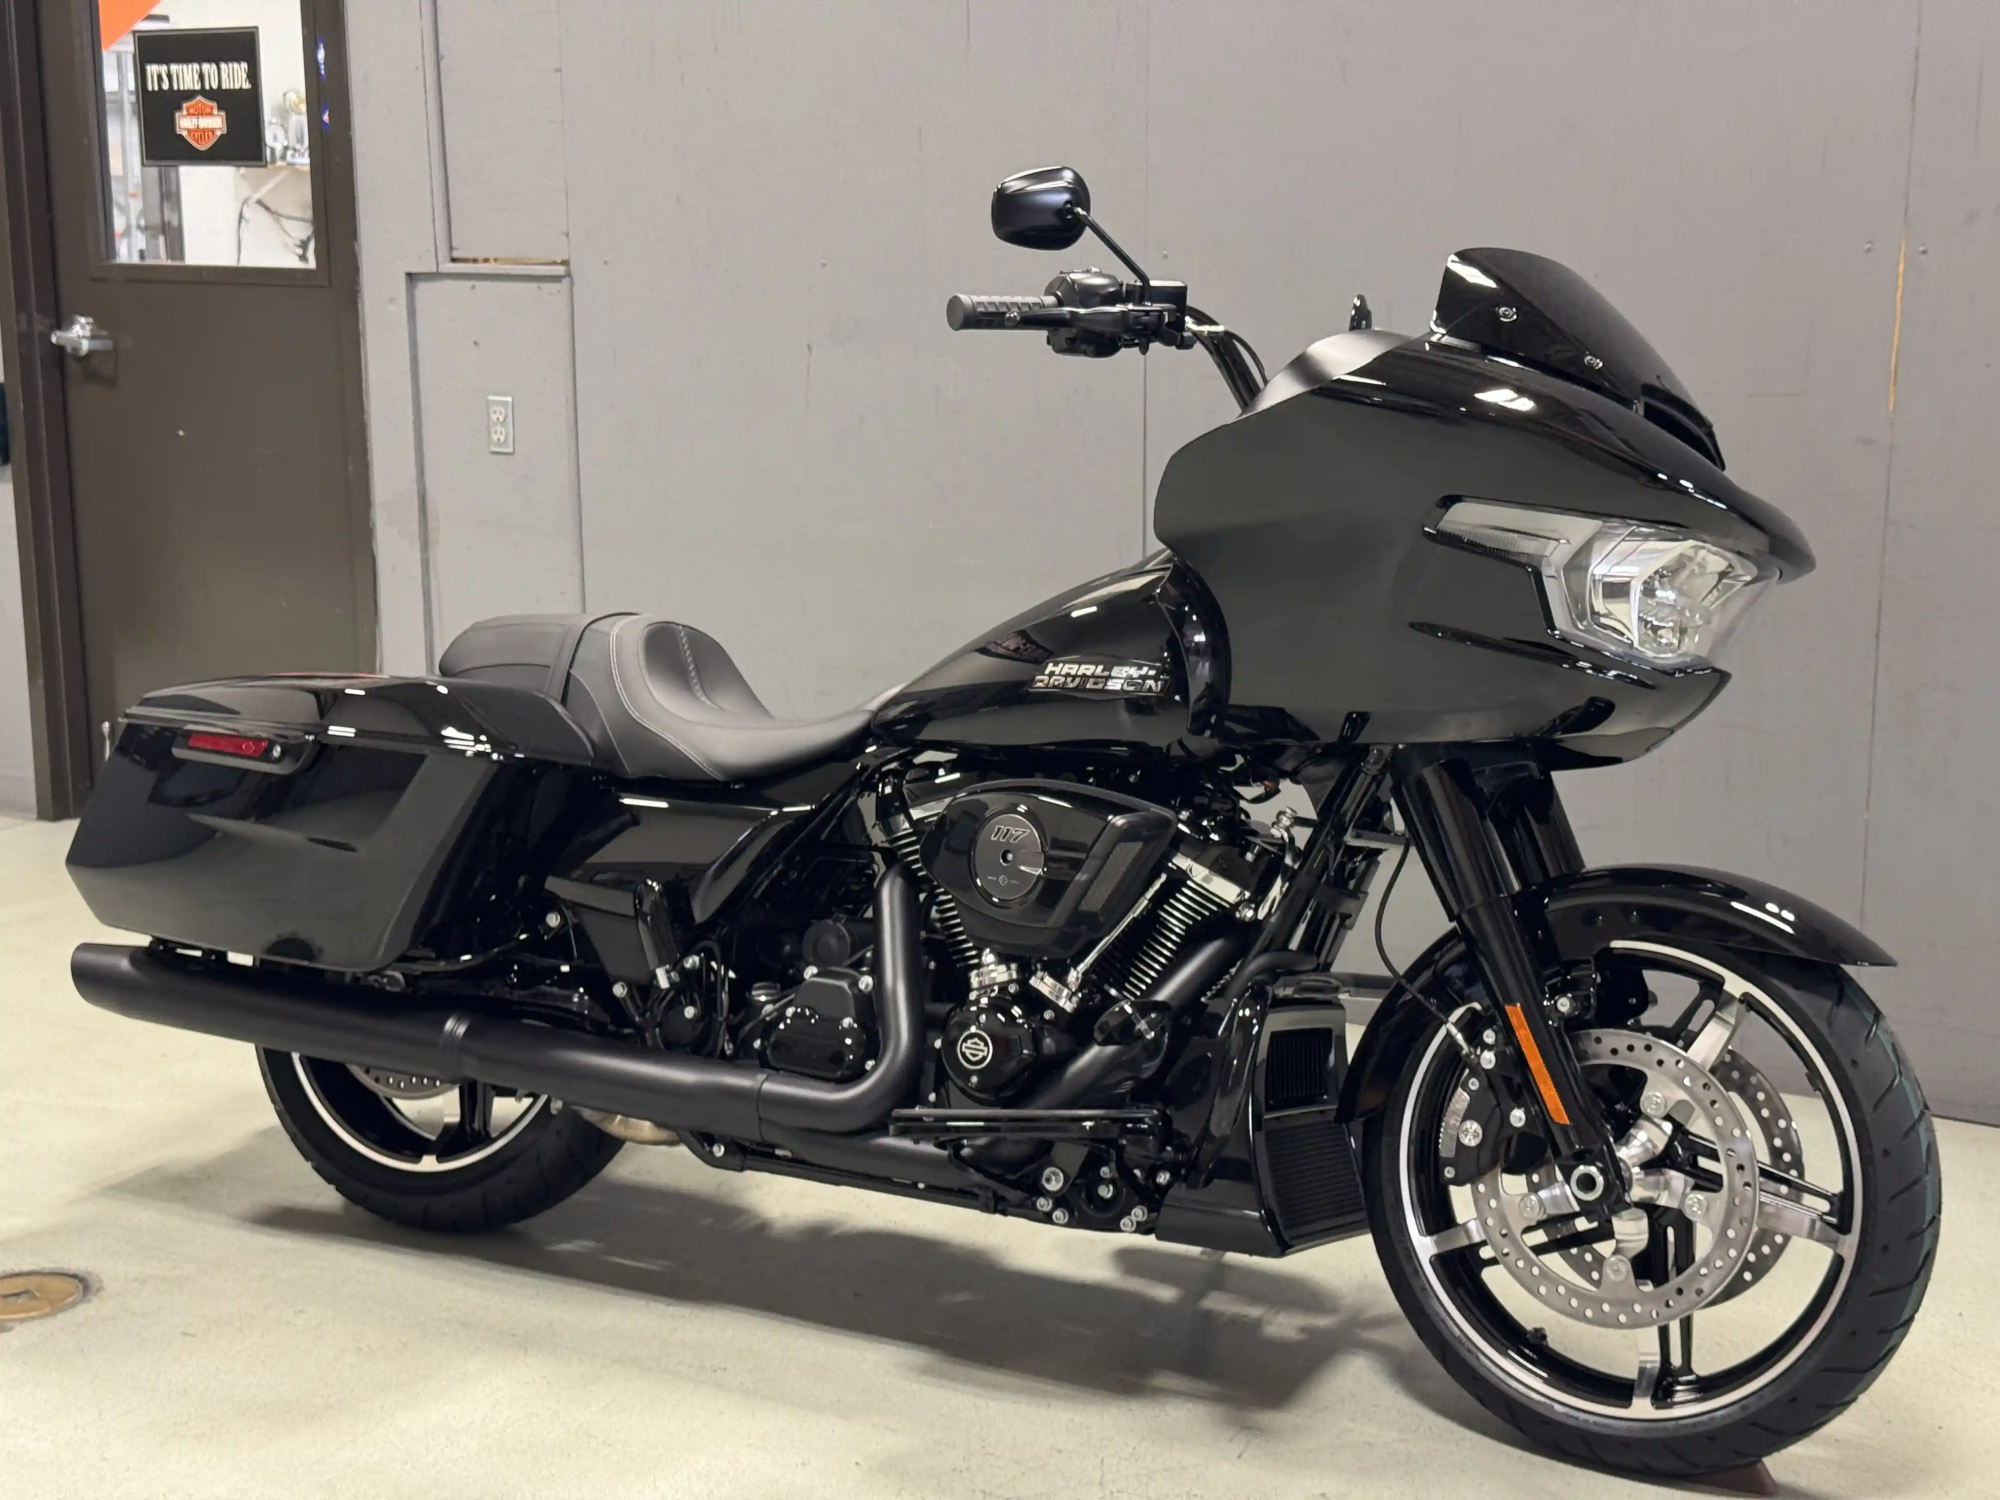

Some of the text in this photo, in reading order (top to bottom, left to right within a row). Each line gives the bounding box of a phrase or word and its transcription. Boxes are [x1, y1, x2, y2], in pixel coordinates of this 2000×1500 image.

[145, 61, 252, 91] IT'S TIME TO RIDE.
[1044, 662, 1157, 678] HARLEY-
[991, 825, 1031, 843] 117
